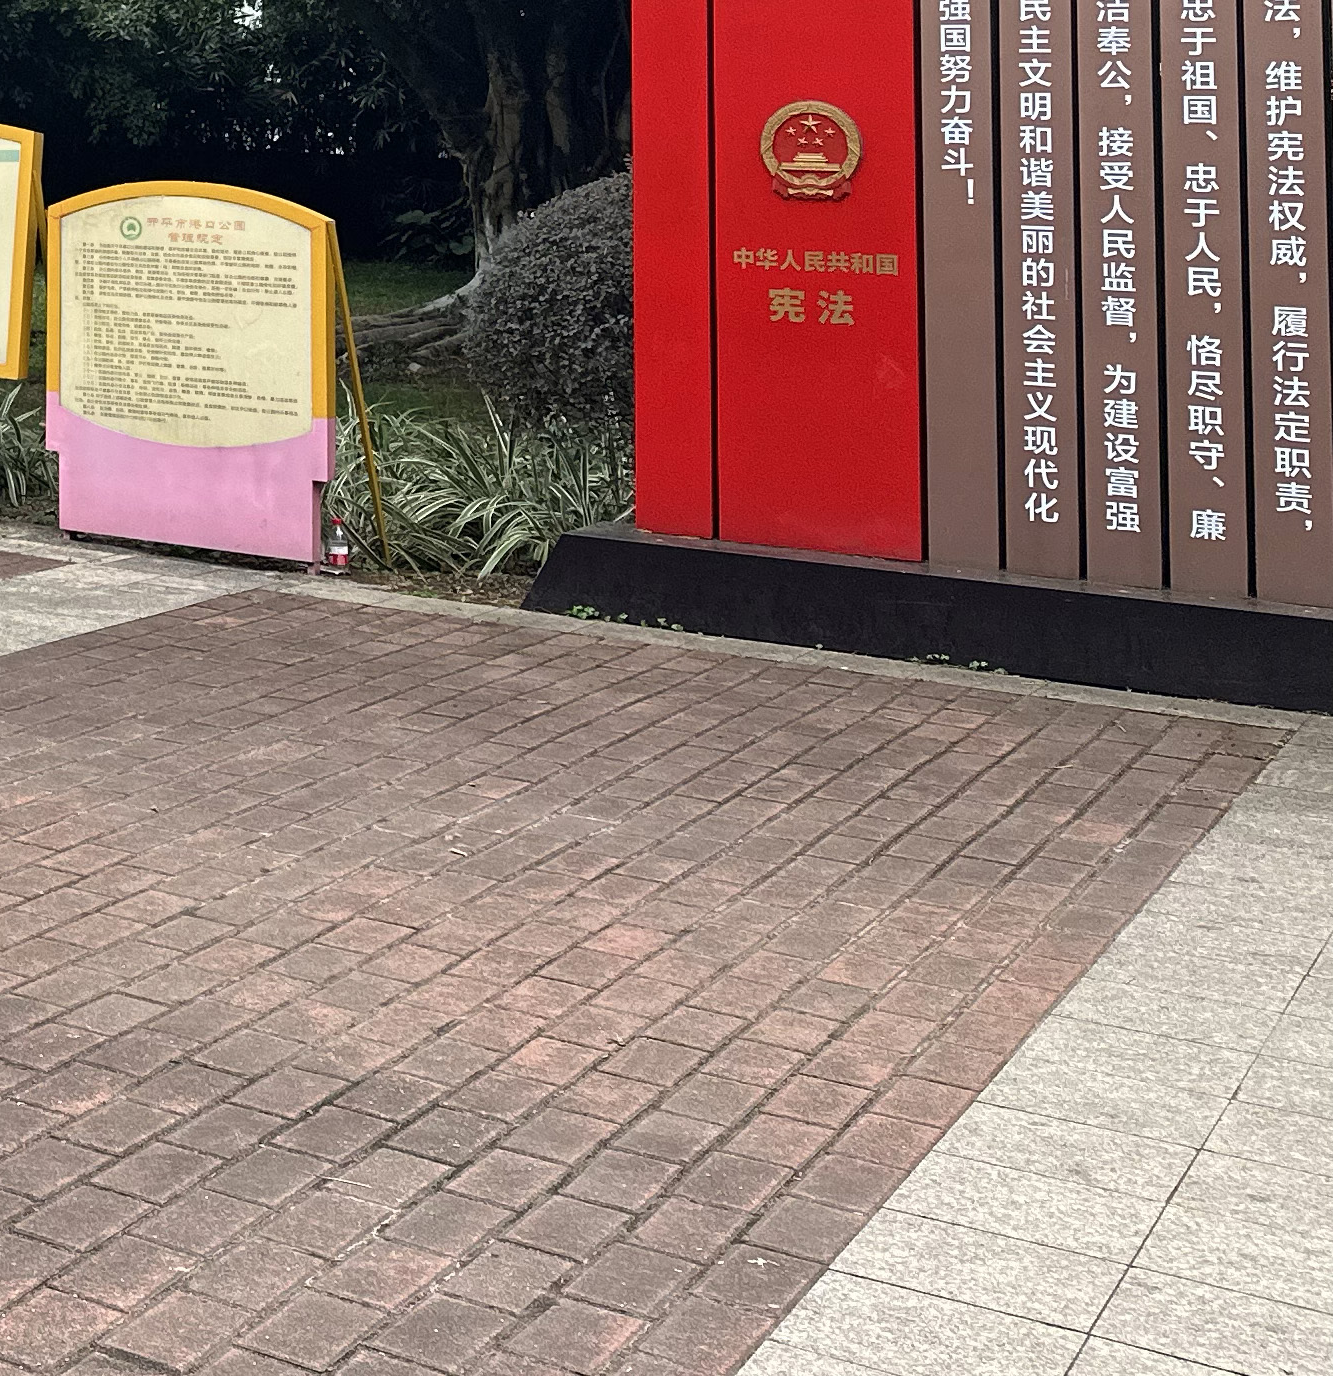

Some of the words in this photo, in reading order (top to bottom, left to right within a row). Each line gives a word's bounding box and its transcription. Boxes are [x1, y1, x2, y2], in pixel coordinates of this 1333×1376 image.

[733, 247, 899, 276] 中华人民共和国
[768, 287, 855, 326] 宪法
